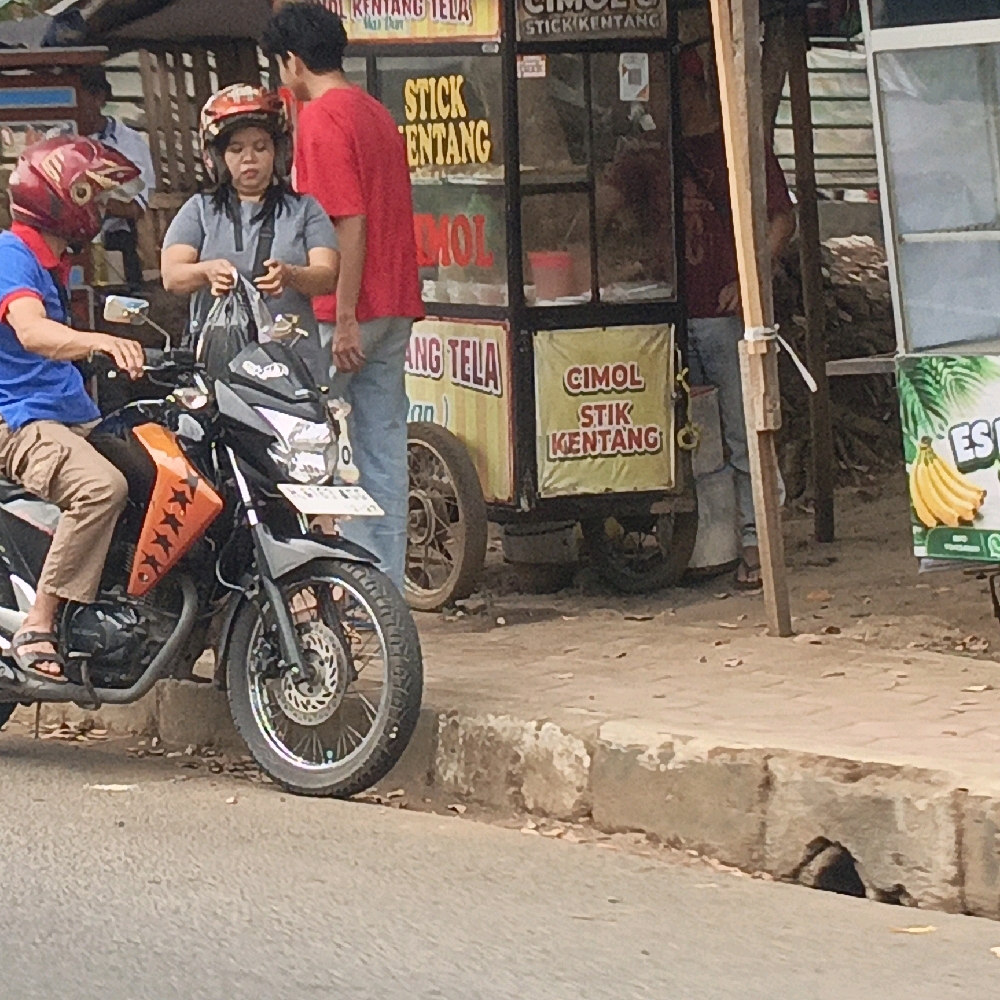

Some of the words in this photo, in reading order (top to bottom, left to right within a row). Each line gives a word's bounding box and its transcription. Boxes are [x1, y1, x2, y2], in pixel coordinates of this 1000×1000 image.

[526, 16, 575, 35] STICK
[579, 13, 661, 32] KENTANG
[405, 75, 466, 121] STICK
[398, 120, 491, 167] ENTANG
[448, 338, 500, 391] TELA
[566, 364, 642, 390] CIMOL
[581, 402, 631, 428] STIK
[551, 426, 658, 455] KENTANG
[950, 422, 995, 463] ES
